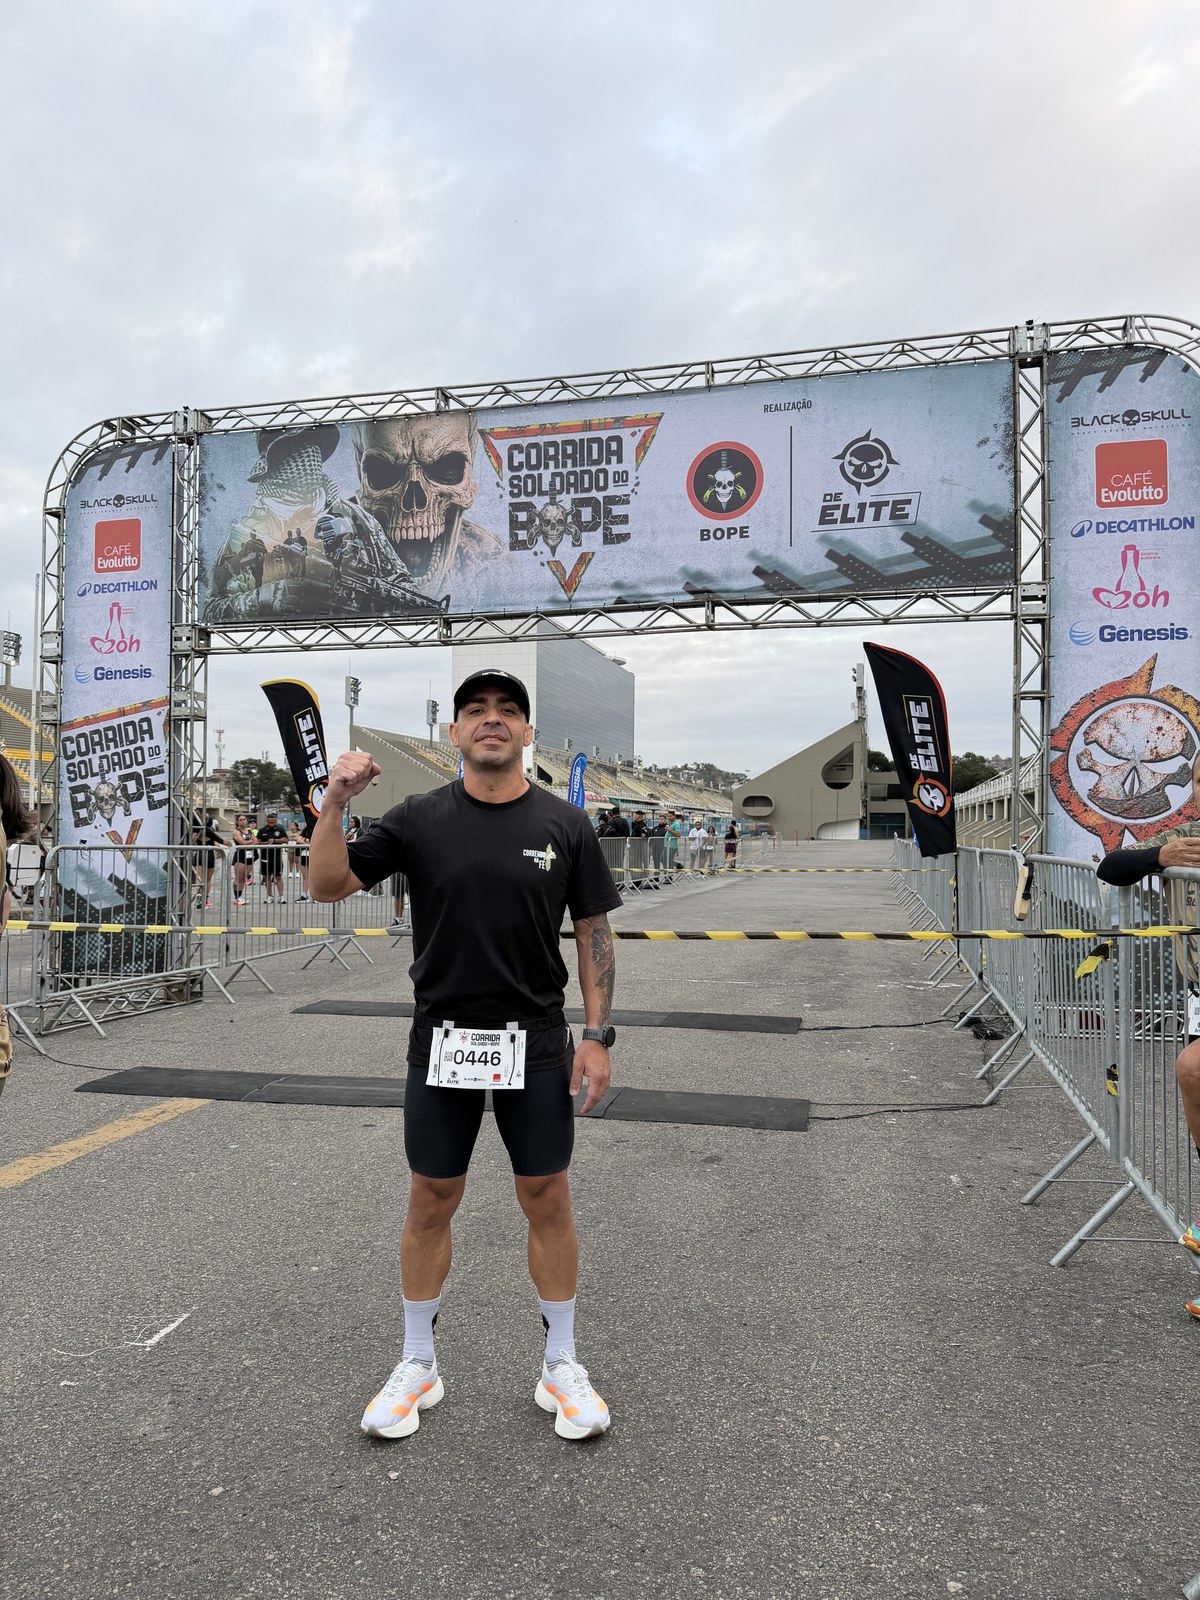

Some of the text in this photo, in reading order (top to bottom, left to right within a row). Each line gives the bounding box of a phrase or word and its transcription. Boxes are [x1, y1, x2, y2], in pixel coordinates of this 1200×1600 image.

[763, 398, 812, 413] REALIZAÇÃO
[1140, 408, 1192, 422] SKULL
[507, 435, 624, 473] CORRIDA
[508, 468, 629, 498] SOLDADO DO
[1110, 469, 1152, 487] CAFÉ
[125, 493, 158, 505] SKULL
[822, 491, 844, 503] DE
[1101, 485, 1164, 503] Evolutto
[818, 498, 913, 526] ELITE
[508, 493, 631, 552] BPE
[1095, 516, 1195, 536] DECATHLON
[700, 525, 750, 542] BOPE
[103, 542, 131, 557] CAFÉ
[97, 556, 138, 569] Evolutto
[93, 579, 158, 595] DECATHLON
[1099, 622, 1189, 643] Gênesis
[93, 664, 152, 681] Gênesis
[61, 716, 155, 761] CORRIDA
[909, 700, 939, 773] ELITE
[297, 714, 328, 780] ELITE
[66, 744, 161, 783] SOLDADO DO
[909, 752, 920, 771] DE
[304, 766, 315, 782] DE
[68, 765, 170, 829] BPE
[471, 1033, 501, 1042] CORRIDA
[453, 1049, 501, 1067] 0446
